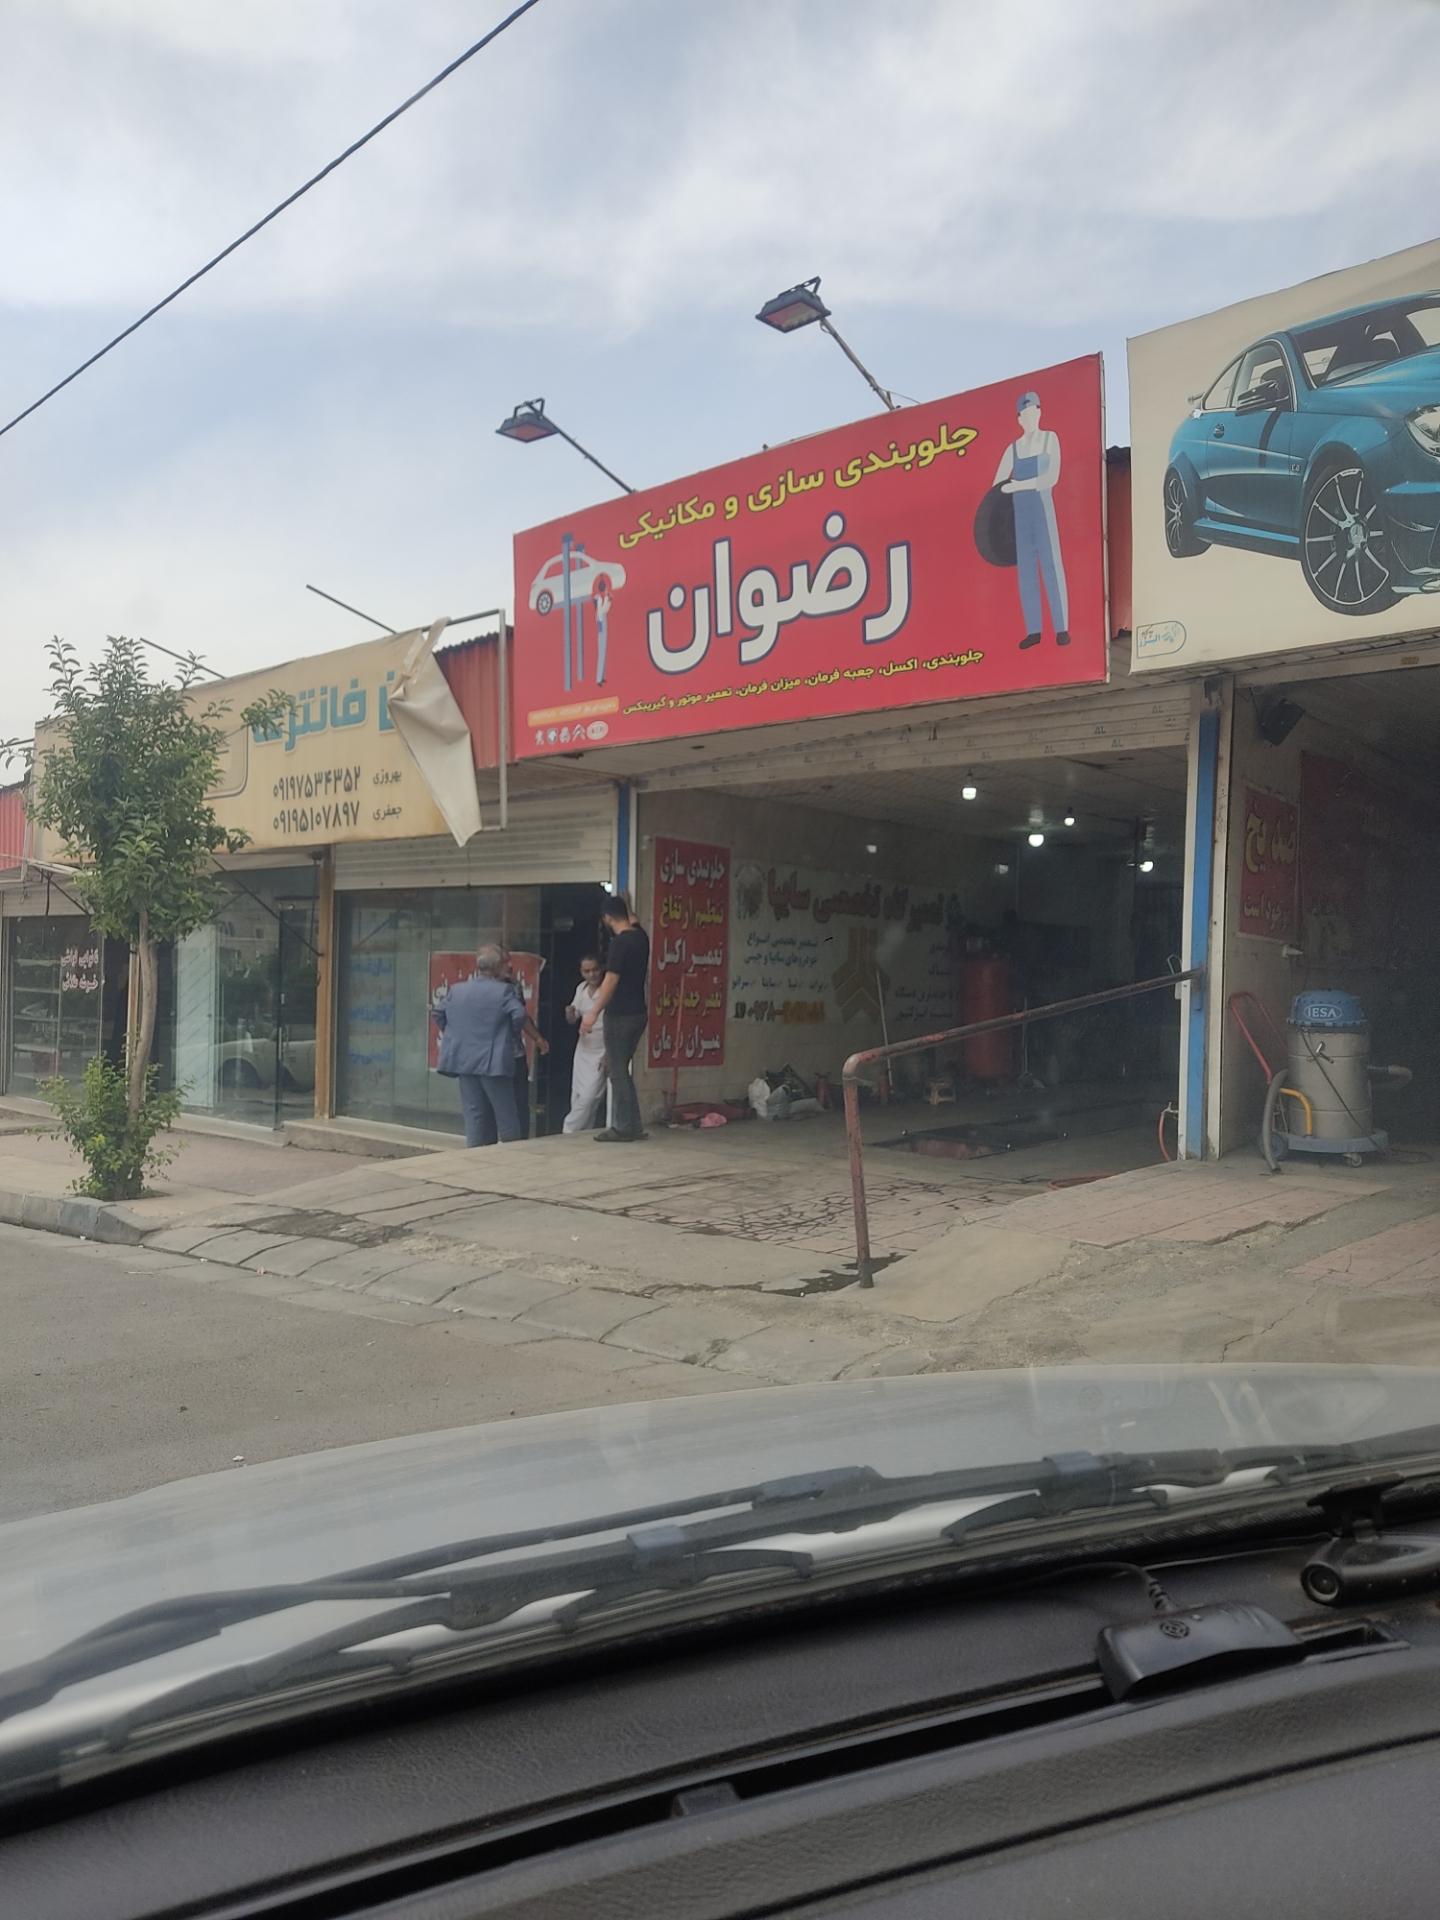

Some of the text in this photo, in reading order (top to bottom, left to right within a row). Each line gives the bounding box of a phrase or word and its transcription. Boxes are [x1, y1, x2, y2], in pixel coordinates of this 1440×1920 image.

[619, 423, 979, 549] جلوبندی سازی و مکانیکی
[646, 510, 912, 675] رضوان
[922, 649, 984, 670] جلوبندی،
[771, 675, 801, 692] میزان
[843, 665, 875, 681] جعبه
[668, 698, 675, 709] و
[676, 692, 702, 707] موتور
[705, 687, 733, 702] تعمیر
[273, 765, 402, 801] بهروزی ۰۹۱۹۷۵۳۴۳۵۲
[273, 800, 402, 833] جعفری ۰۹۱۹۵۱۰۷۸۹۷
[657, 937, 686, 971] اکسل
[1307, 1007, 1337, 1018] IESA
[685, 1024, 720, 1058] میزان
